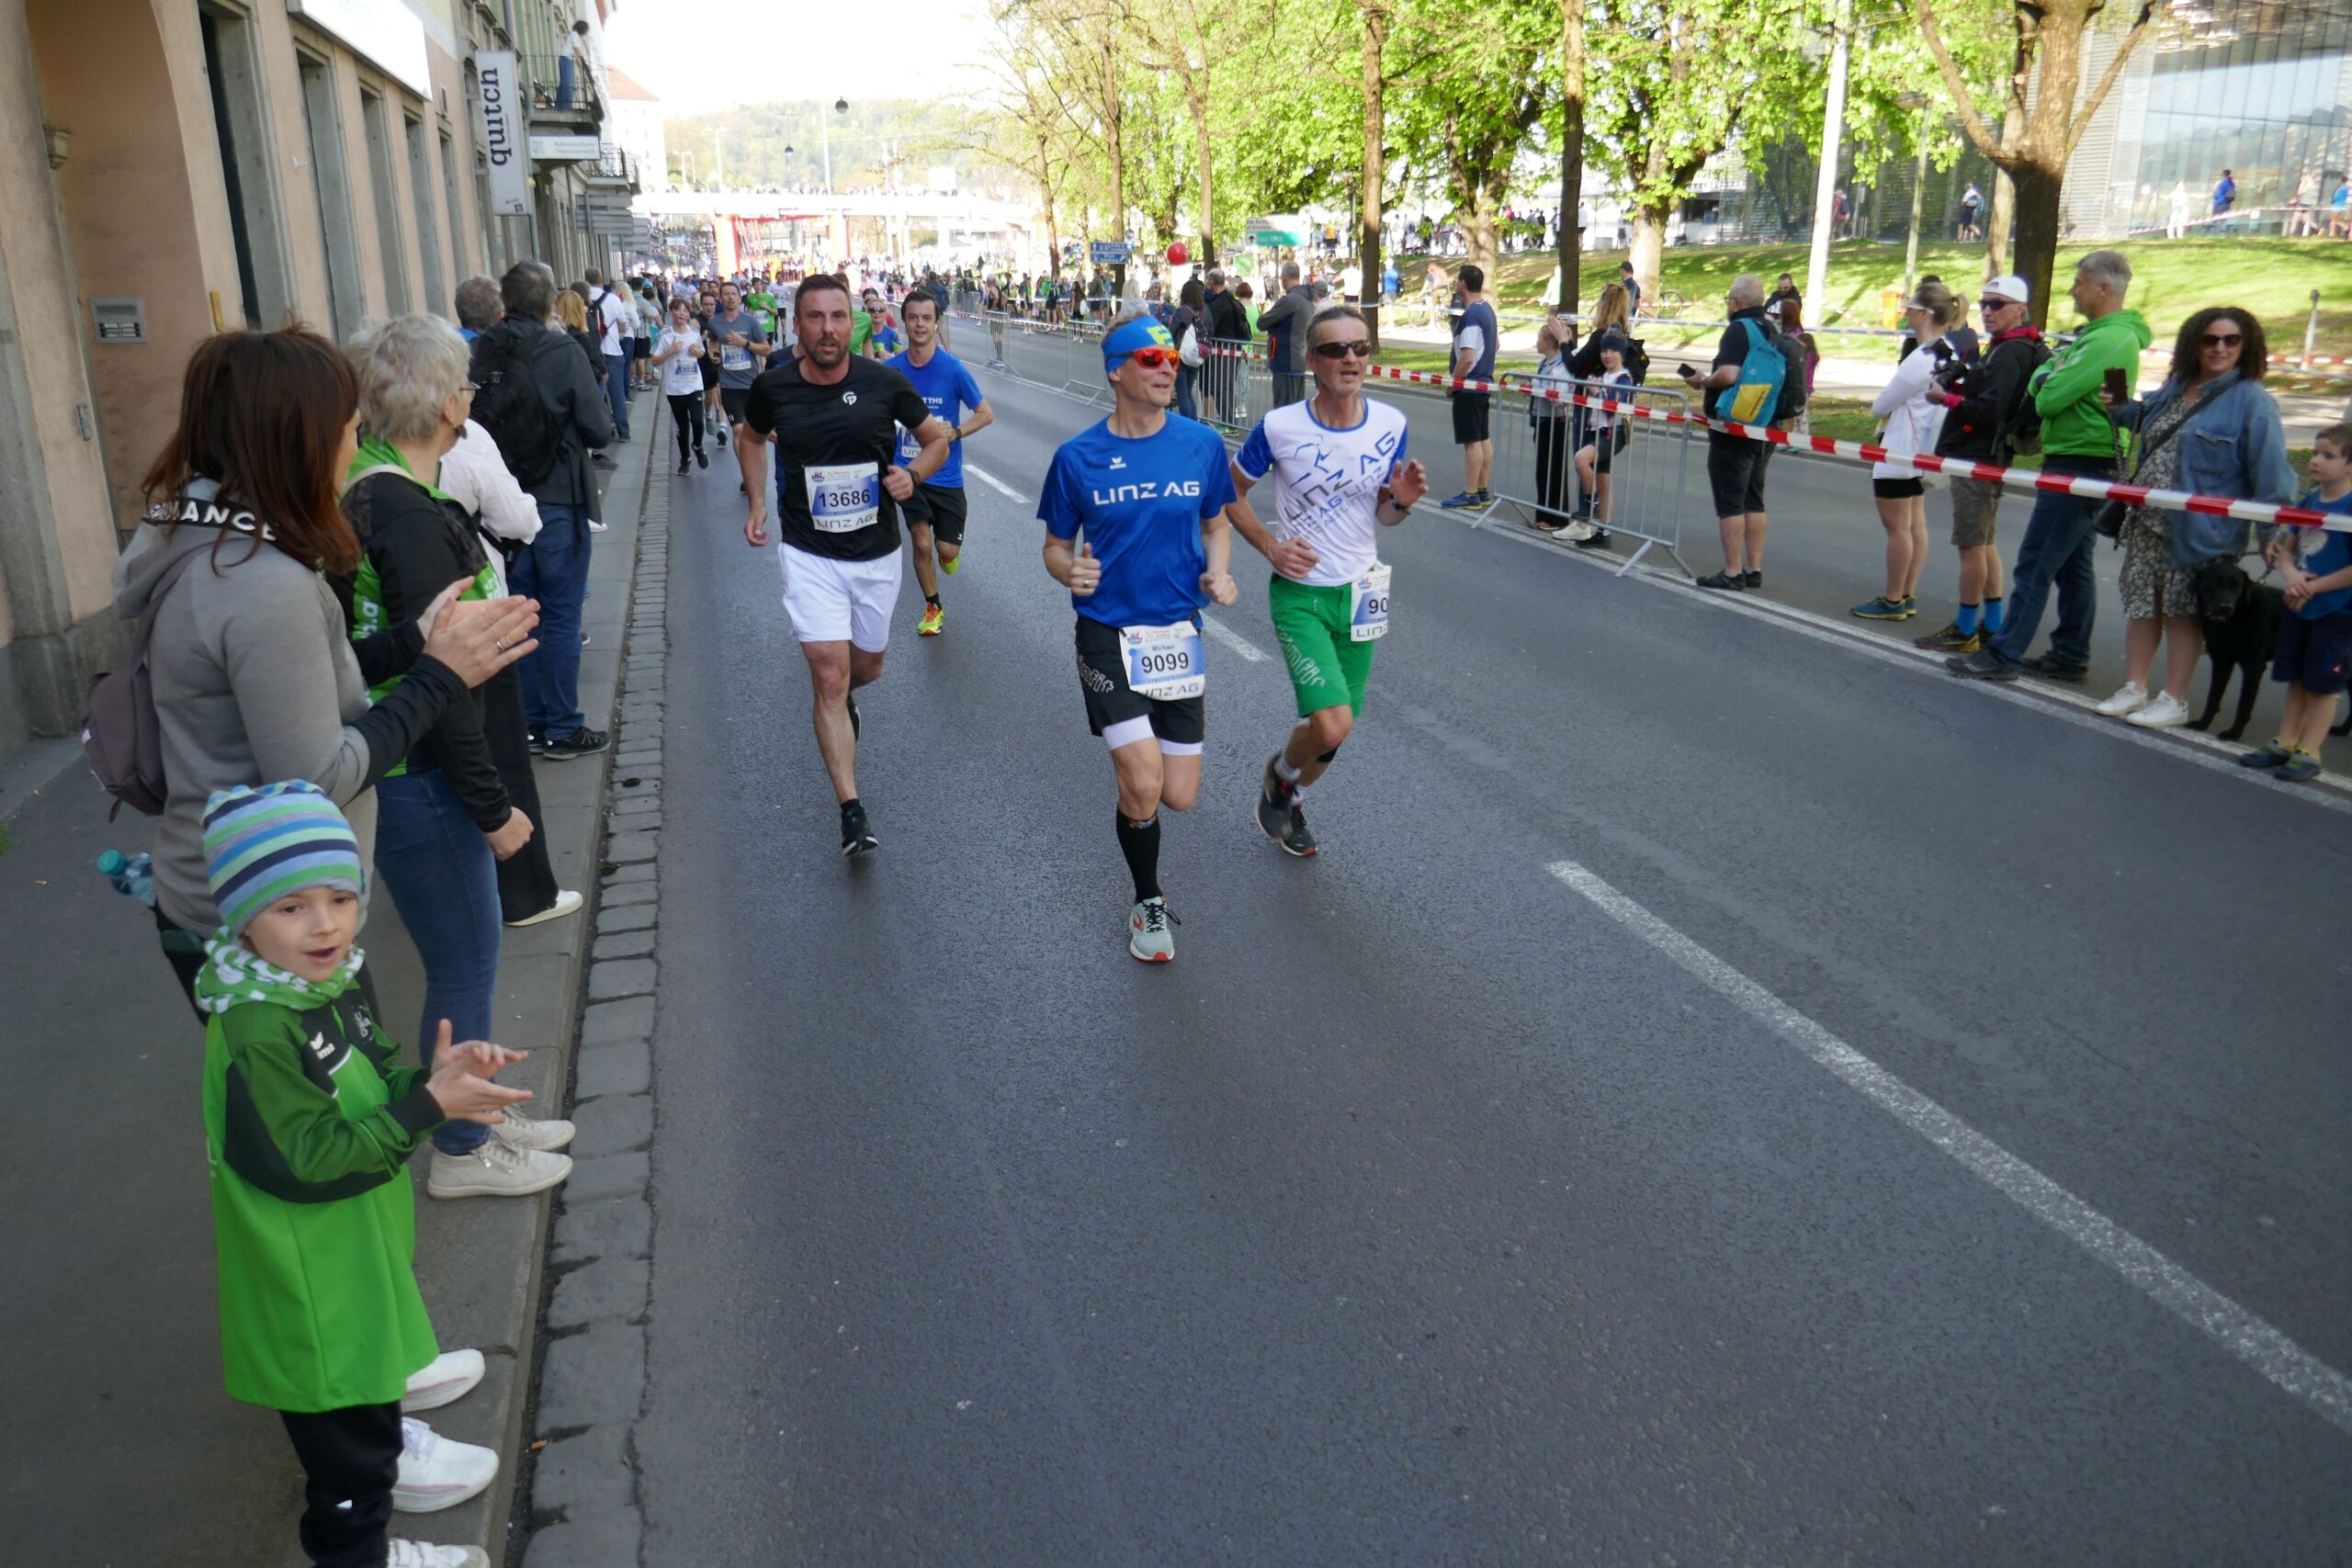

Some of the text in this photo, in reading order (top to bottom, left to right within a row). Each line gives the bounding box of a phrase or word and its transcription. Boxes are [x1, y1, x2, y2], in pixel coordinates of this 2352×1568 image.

[1360, 431, 1396, 476] AG
[819, 489, 871, 508] 13686
[1092, 480, 1200, 505] LINZ AG
[817, 514, 874, 528] LINZ AG
[1141, 652, 1189, 673] 9099
[1177, 683, 1200, 694] AG
